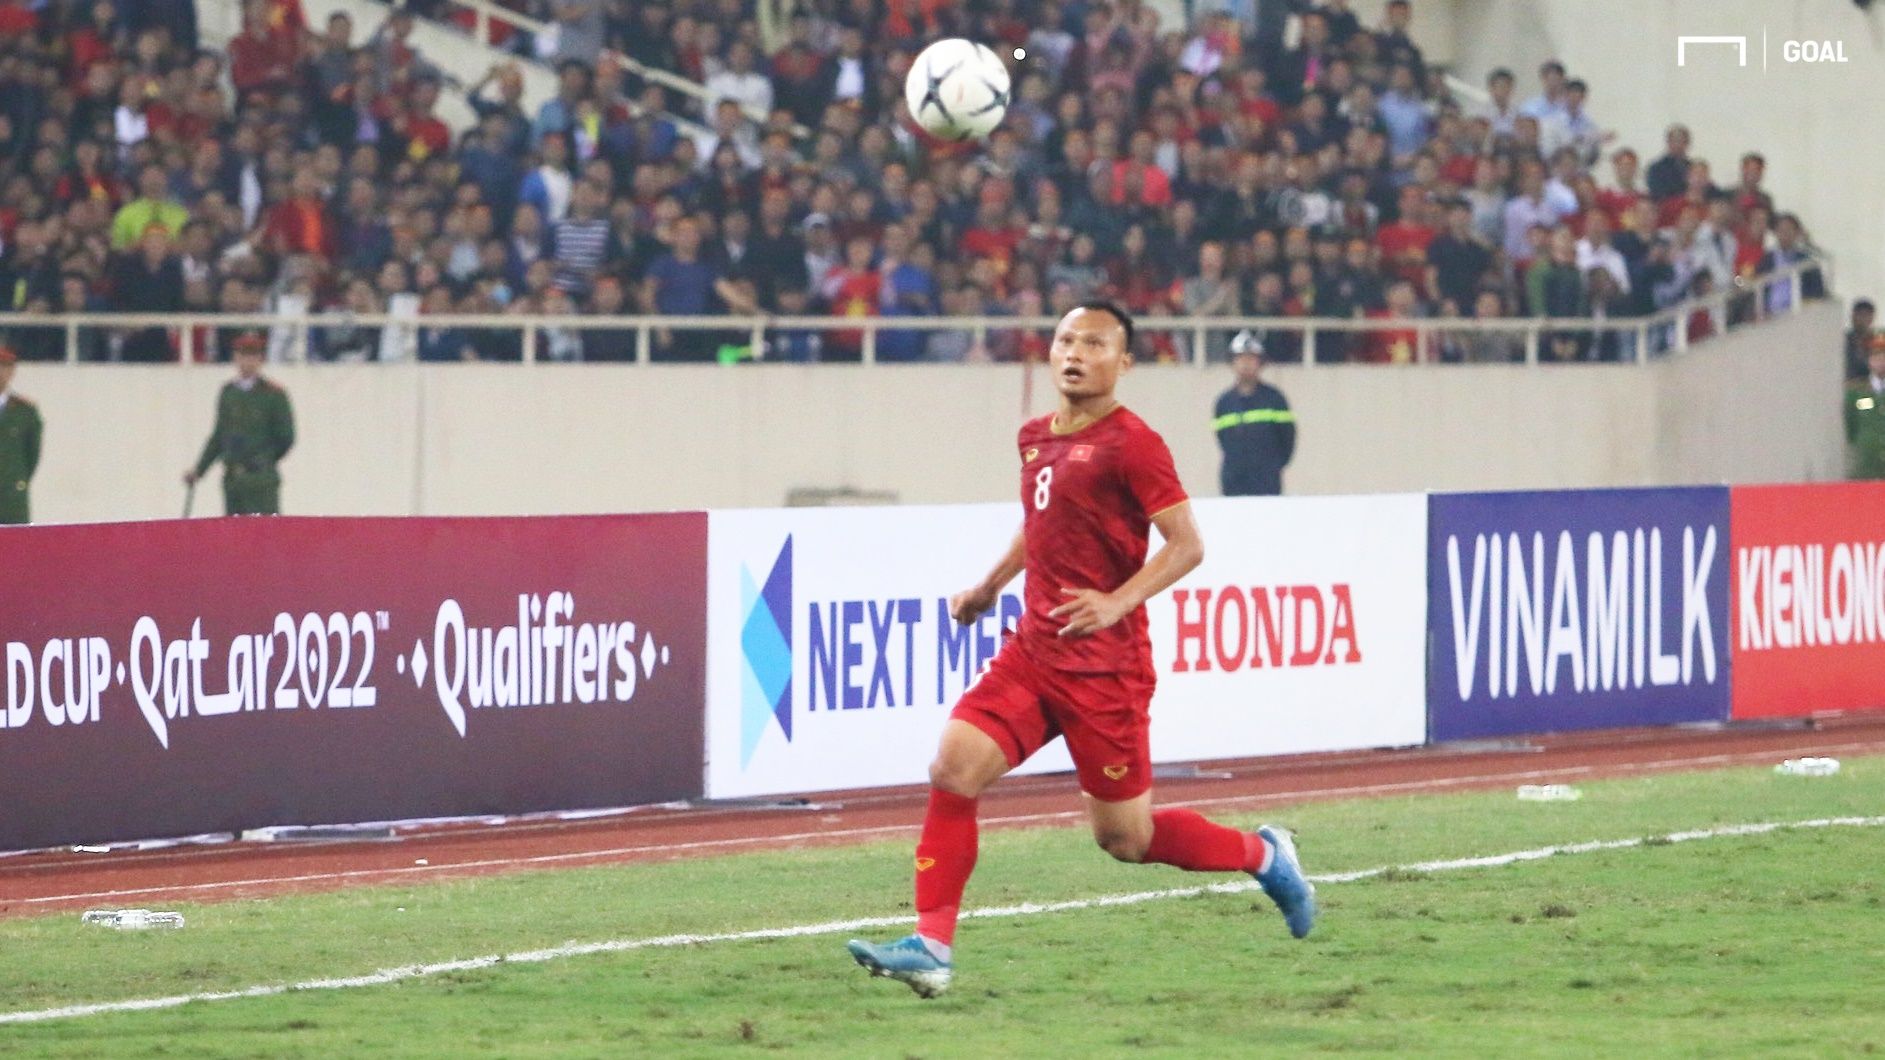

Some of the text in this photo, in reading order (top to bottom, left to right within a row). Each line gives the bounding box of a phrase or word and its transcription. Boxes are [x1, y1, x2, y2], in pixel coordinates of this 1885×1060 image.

[1034, 466, 1053, 511] 8
[0, 641, 34, 728] D
[40, 636, 112, 727] CUP
[434, 591, 637, 738] Qualifiers
[808, 597, 922, 712] NEXT
[1172, 583, 1362, 673] HONDA
[1447, 525, 1718, 702] VINAMILK
